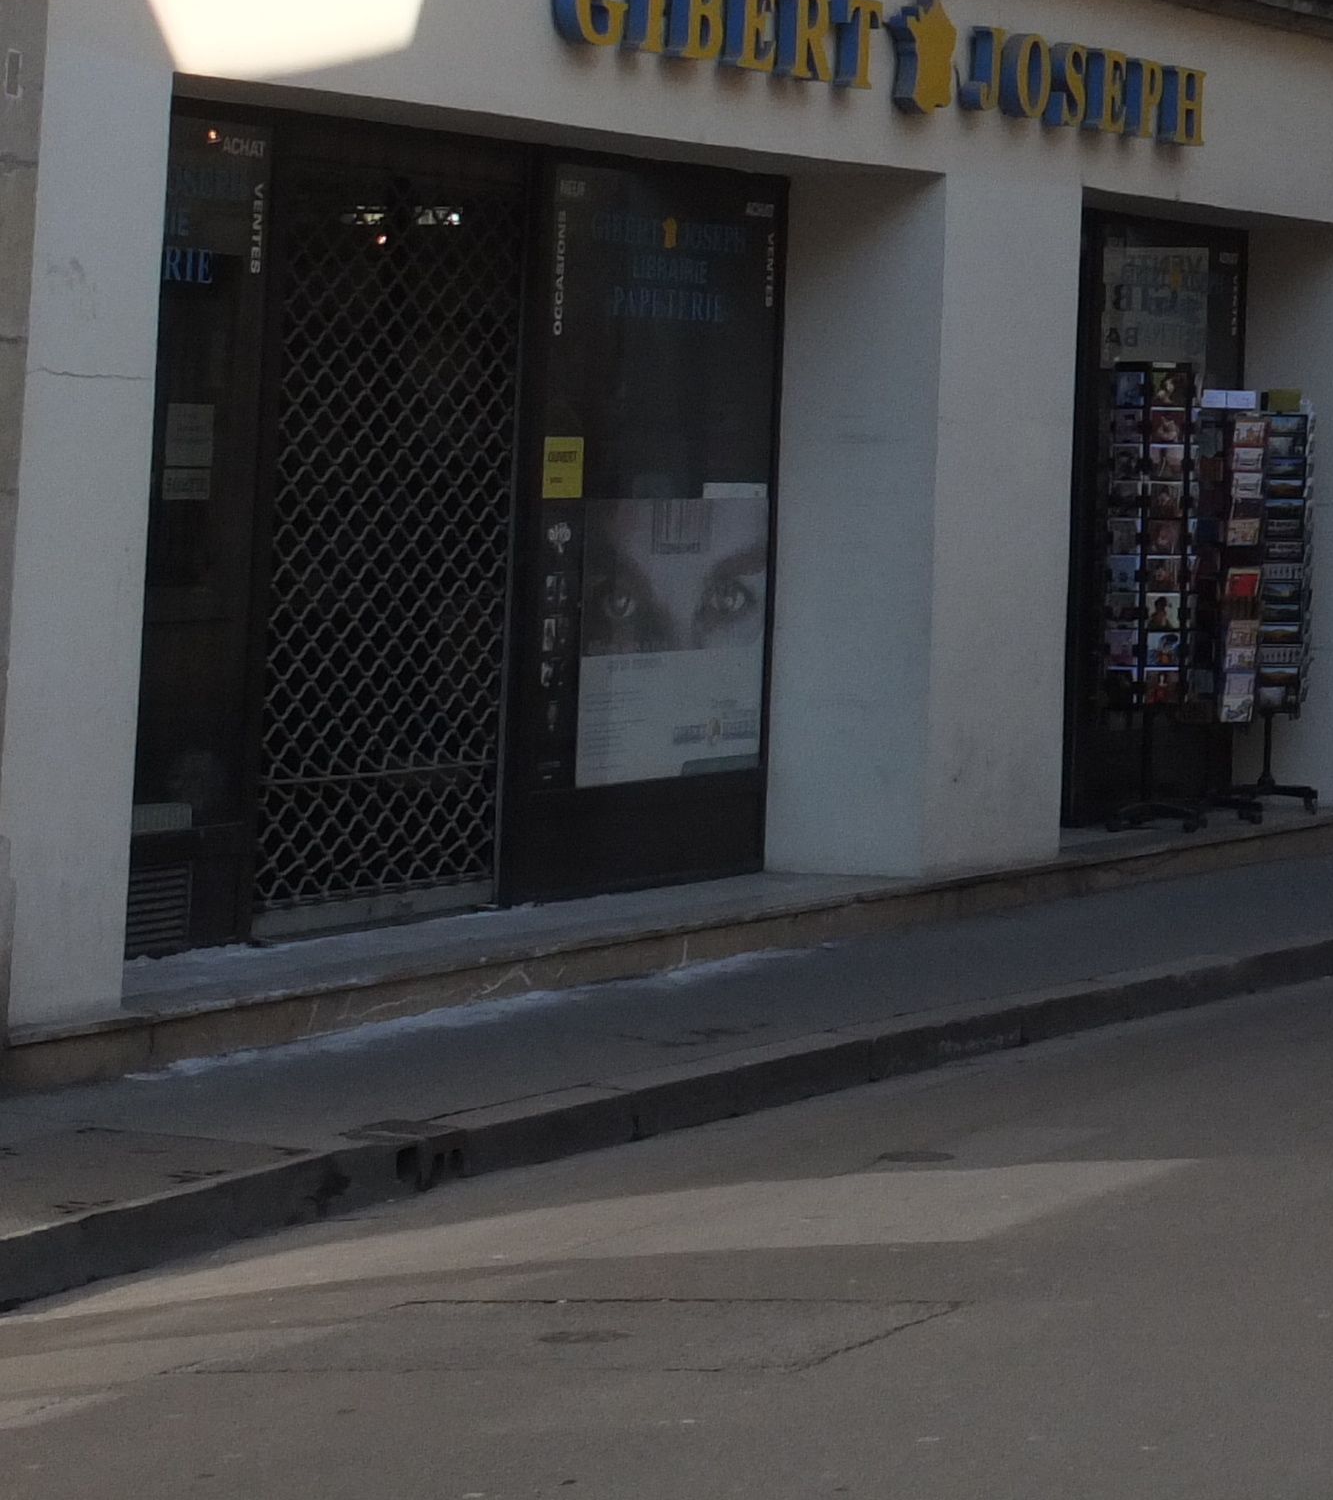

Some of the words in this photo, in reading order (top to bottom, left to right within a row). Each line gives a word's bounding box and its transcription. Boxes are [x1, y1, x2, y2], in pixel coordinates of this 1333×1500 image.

[959, 26, 1206, 146] JOSEPH
[221, 137, 266, 159] ACHAT
[249, 183, 266, 276] VENTES
[553, 210, 567, 337] OCCASIONS
[613, 286, 724, 323] PAPETERIE
